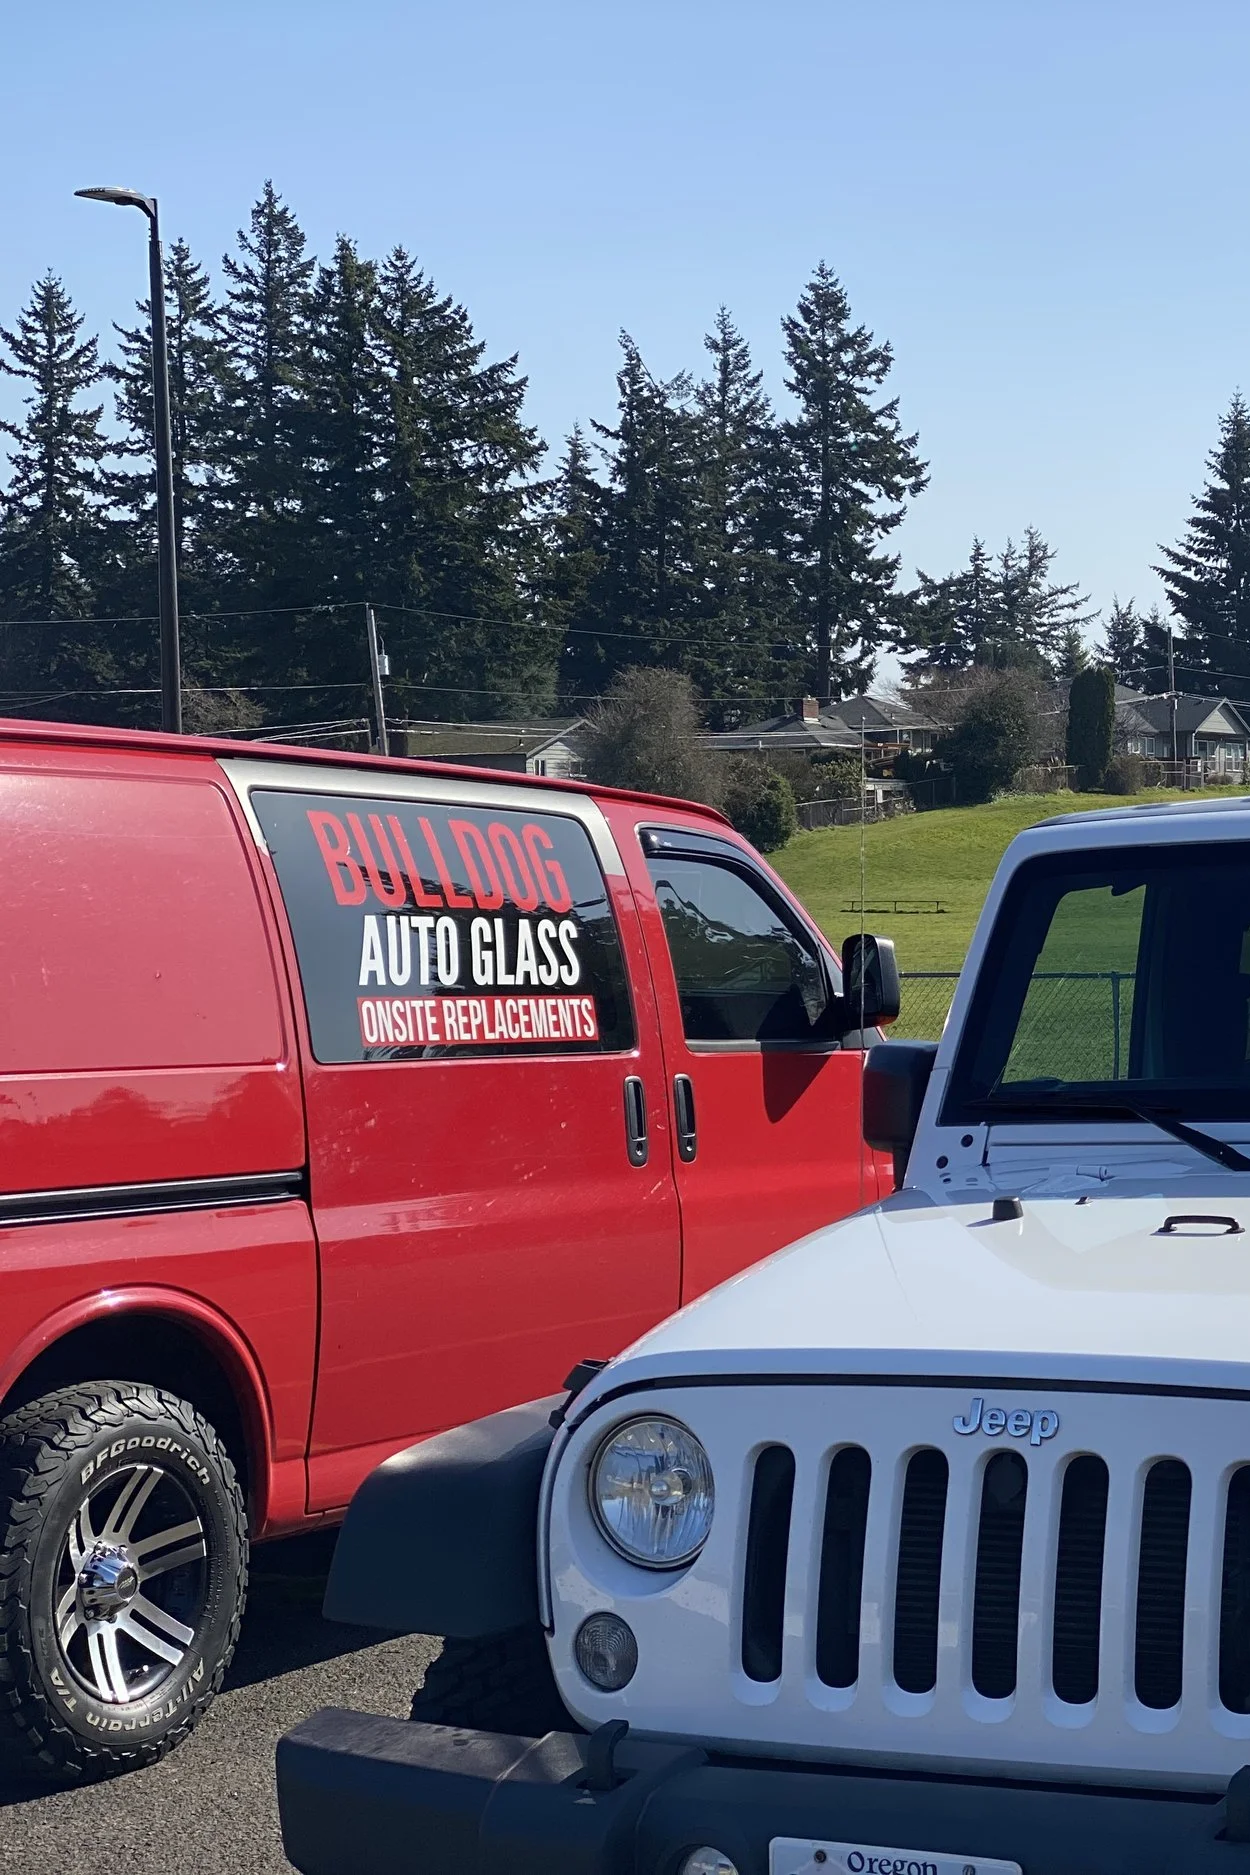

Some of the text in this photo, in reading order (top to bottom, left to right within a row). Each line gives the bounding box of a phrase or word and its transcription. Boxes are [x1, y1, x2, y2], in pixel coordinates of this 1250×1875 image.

[306, 810, 573, 913] BULLDOG
[358, 914, 581, 986] AUTO GLASS
[362, 997, 595, 1043] ONSITE REPLACEMENTS
[952, 1397, 1060, 1446] Jeep
[80, 1435, 211, 1486] BFGoodrich
[85, 1657, 205, 1732] All-Terrain
[847, 1851, 938, 1875] Oregon
